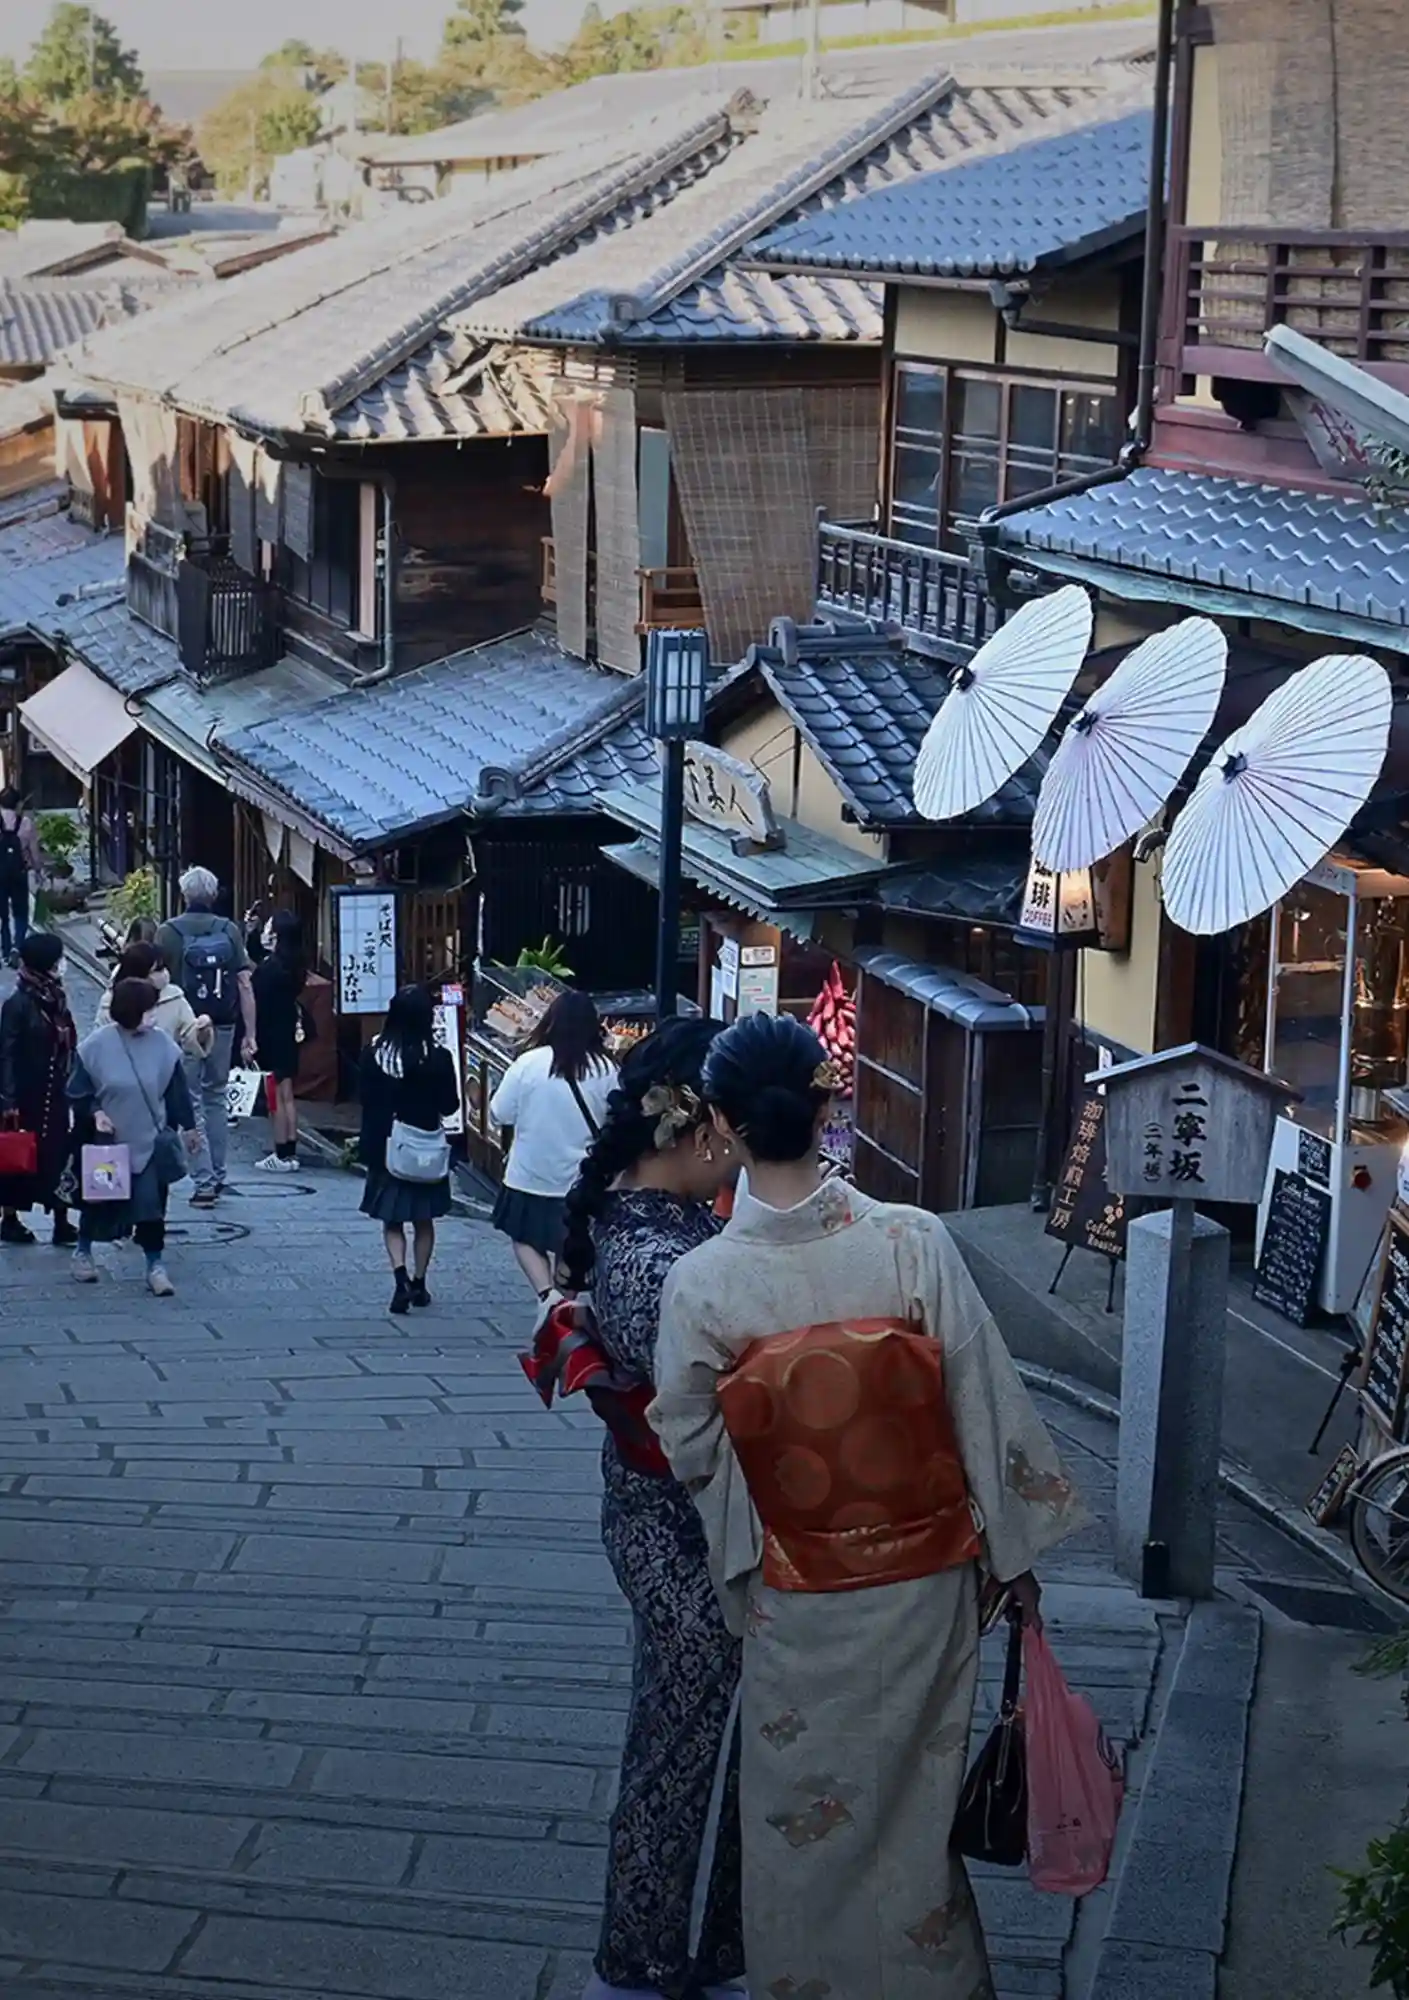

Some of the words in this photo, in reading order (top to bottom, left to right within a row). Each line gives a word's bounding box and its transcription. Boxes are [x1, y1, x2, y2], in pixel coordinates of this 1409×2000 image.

[1023, 907, 1053, 928] COFFEE
[342, 953, 363, 1003] ふたば
[1168, 1082, 1208, 1183] 二寧坂
[1085, 1218, 1117, 1239] Coffee
[1087, 1233, 1124, 1255] Roaster
